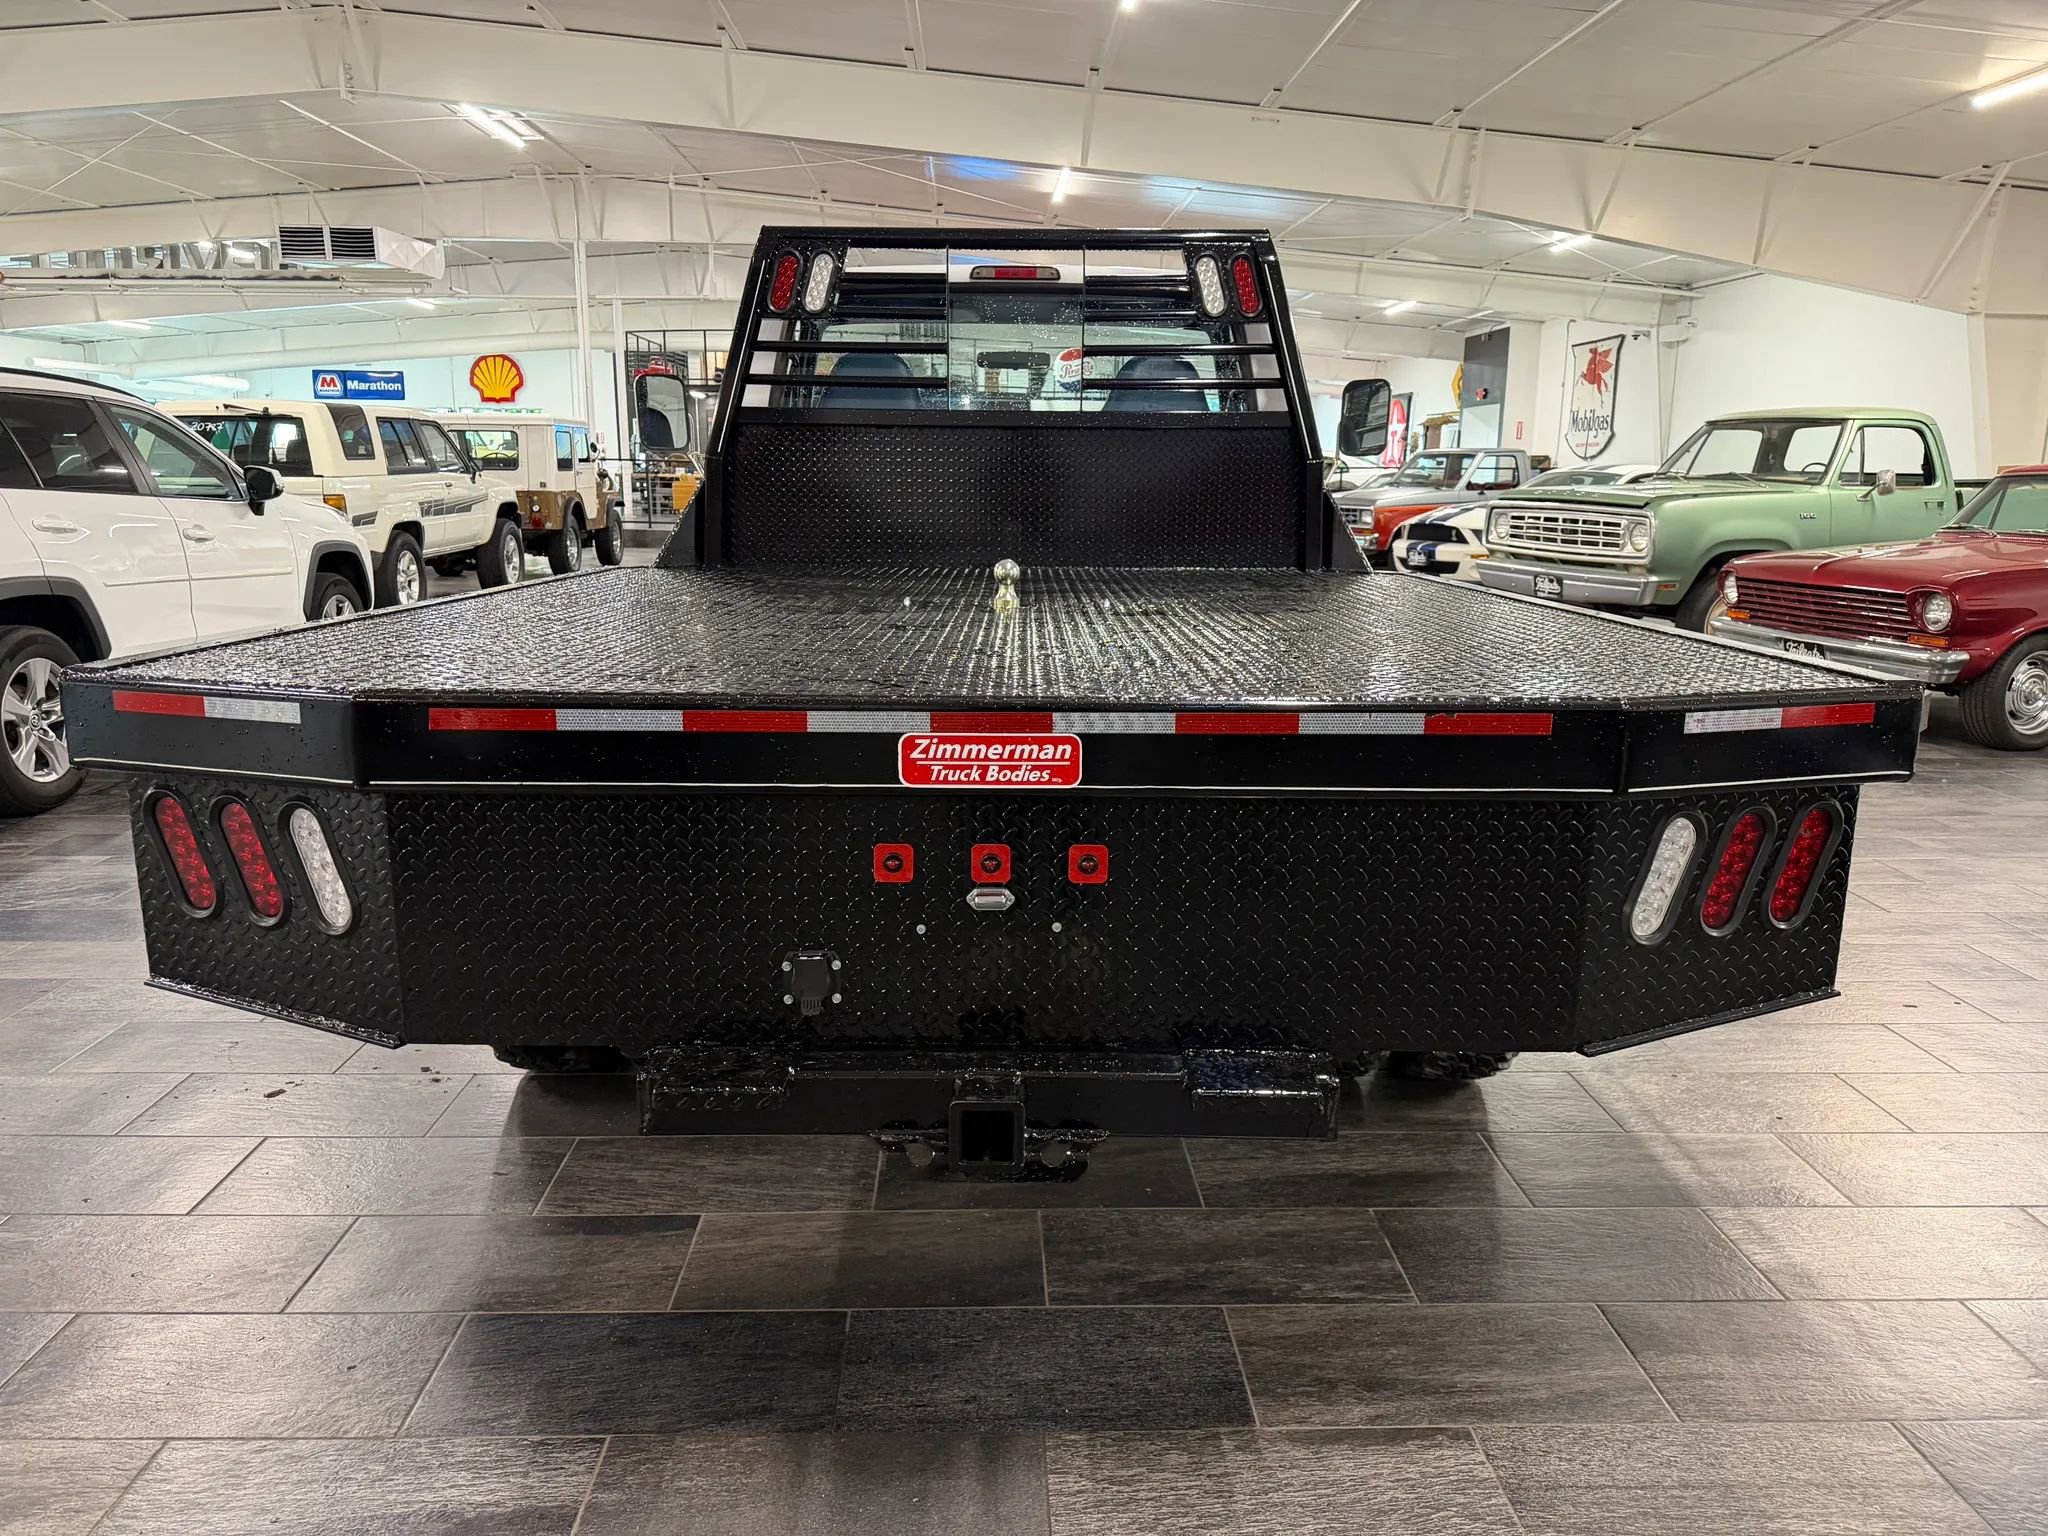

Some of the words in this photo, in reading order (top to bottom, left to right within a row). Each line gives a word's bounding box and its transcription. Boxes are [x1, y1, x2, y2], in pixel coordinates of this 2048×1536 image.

[346, 379, 402, 391] Marathon
[1571, 408, 1610, 438] Mobilgas
[909, 738, 1072, 759] Zimmerman
[930, 765, 983, 781] Truck
[985, 765, 1051, 782] Bodies
